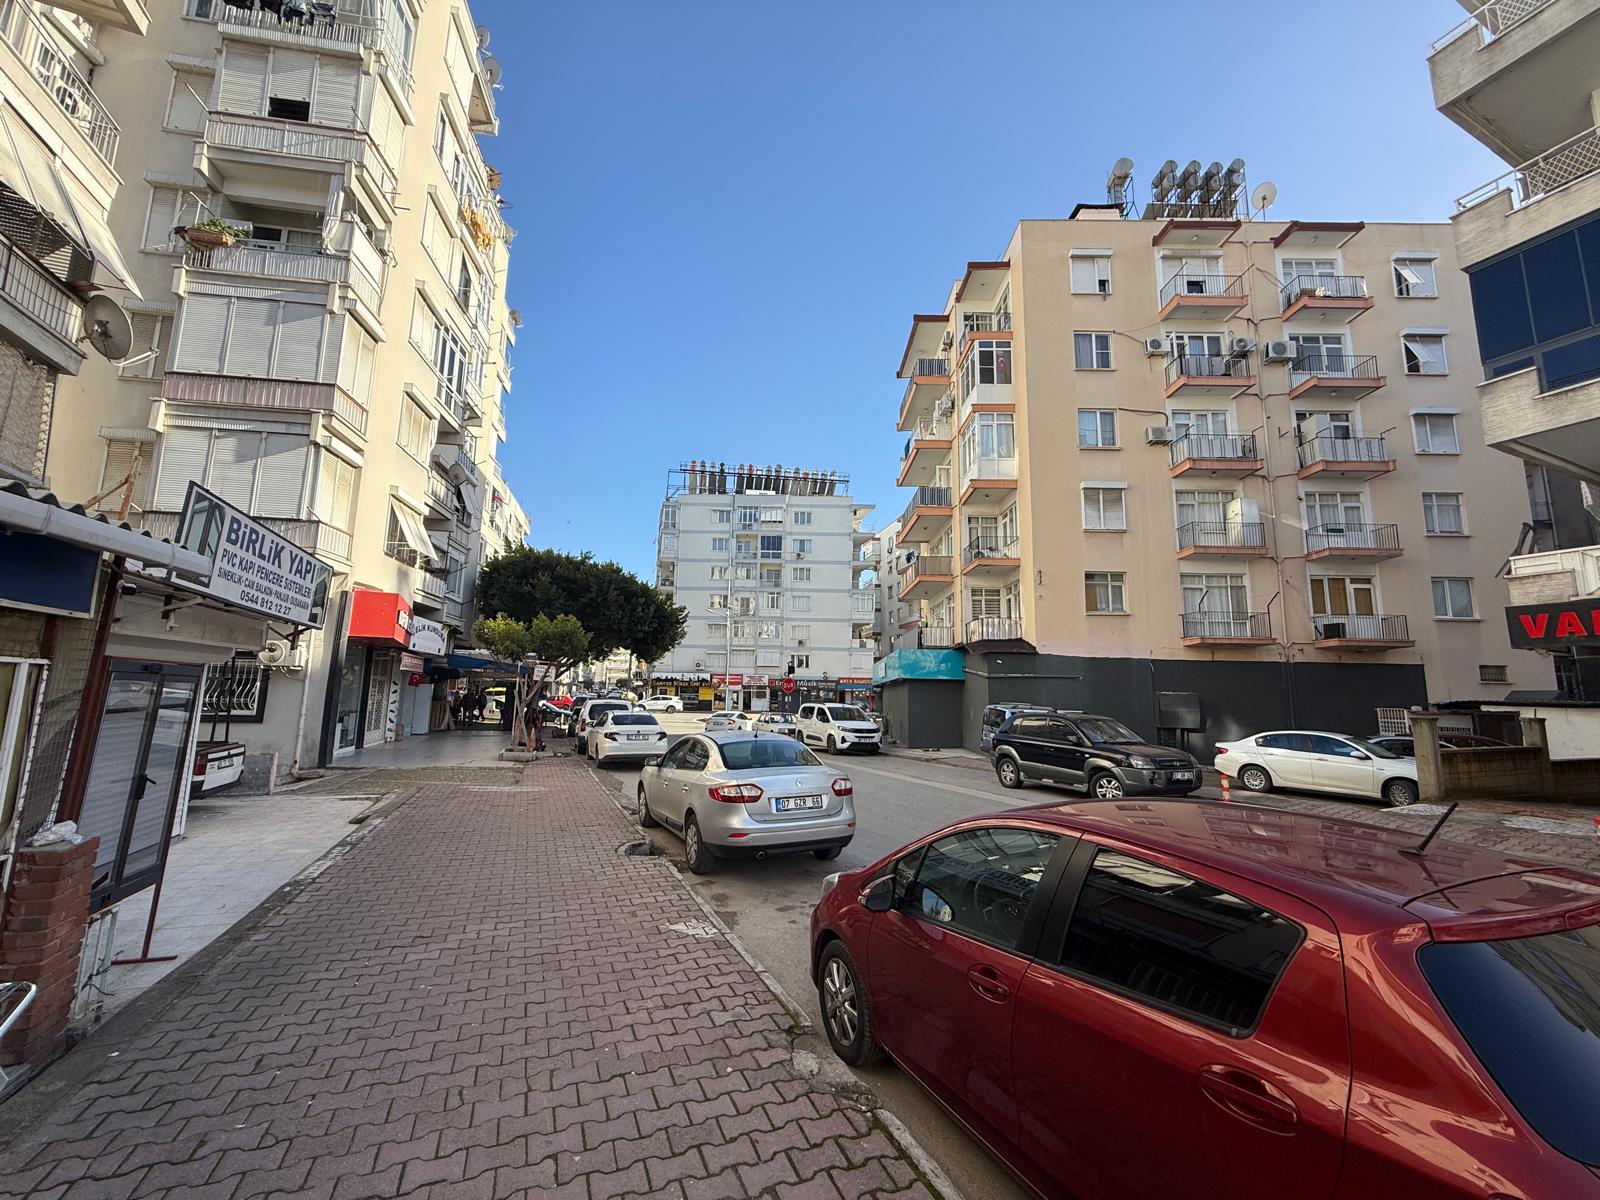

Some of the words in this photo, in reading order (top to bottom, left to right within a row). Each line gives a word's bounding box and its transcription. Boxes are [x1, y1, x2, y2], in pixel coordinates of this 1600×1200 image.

[220, 547, 238, 568] PVC
[238, 555, 256, 576] KAPI
[256, 564, 284, 588] PENCERE
[288, 549, 317, 584] YAPI
[240, 590, 259, 606] 0544
[260, 597, 274, 611] 812
[274, 603, 283, 615] 12
[283, 606, 292, 616] 27
[781, 799, 790, 808] 07
[793, 798, 807, 808] GZR
